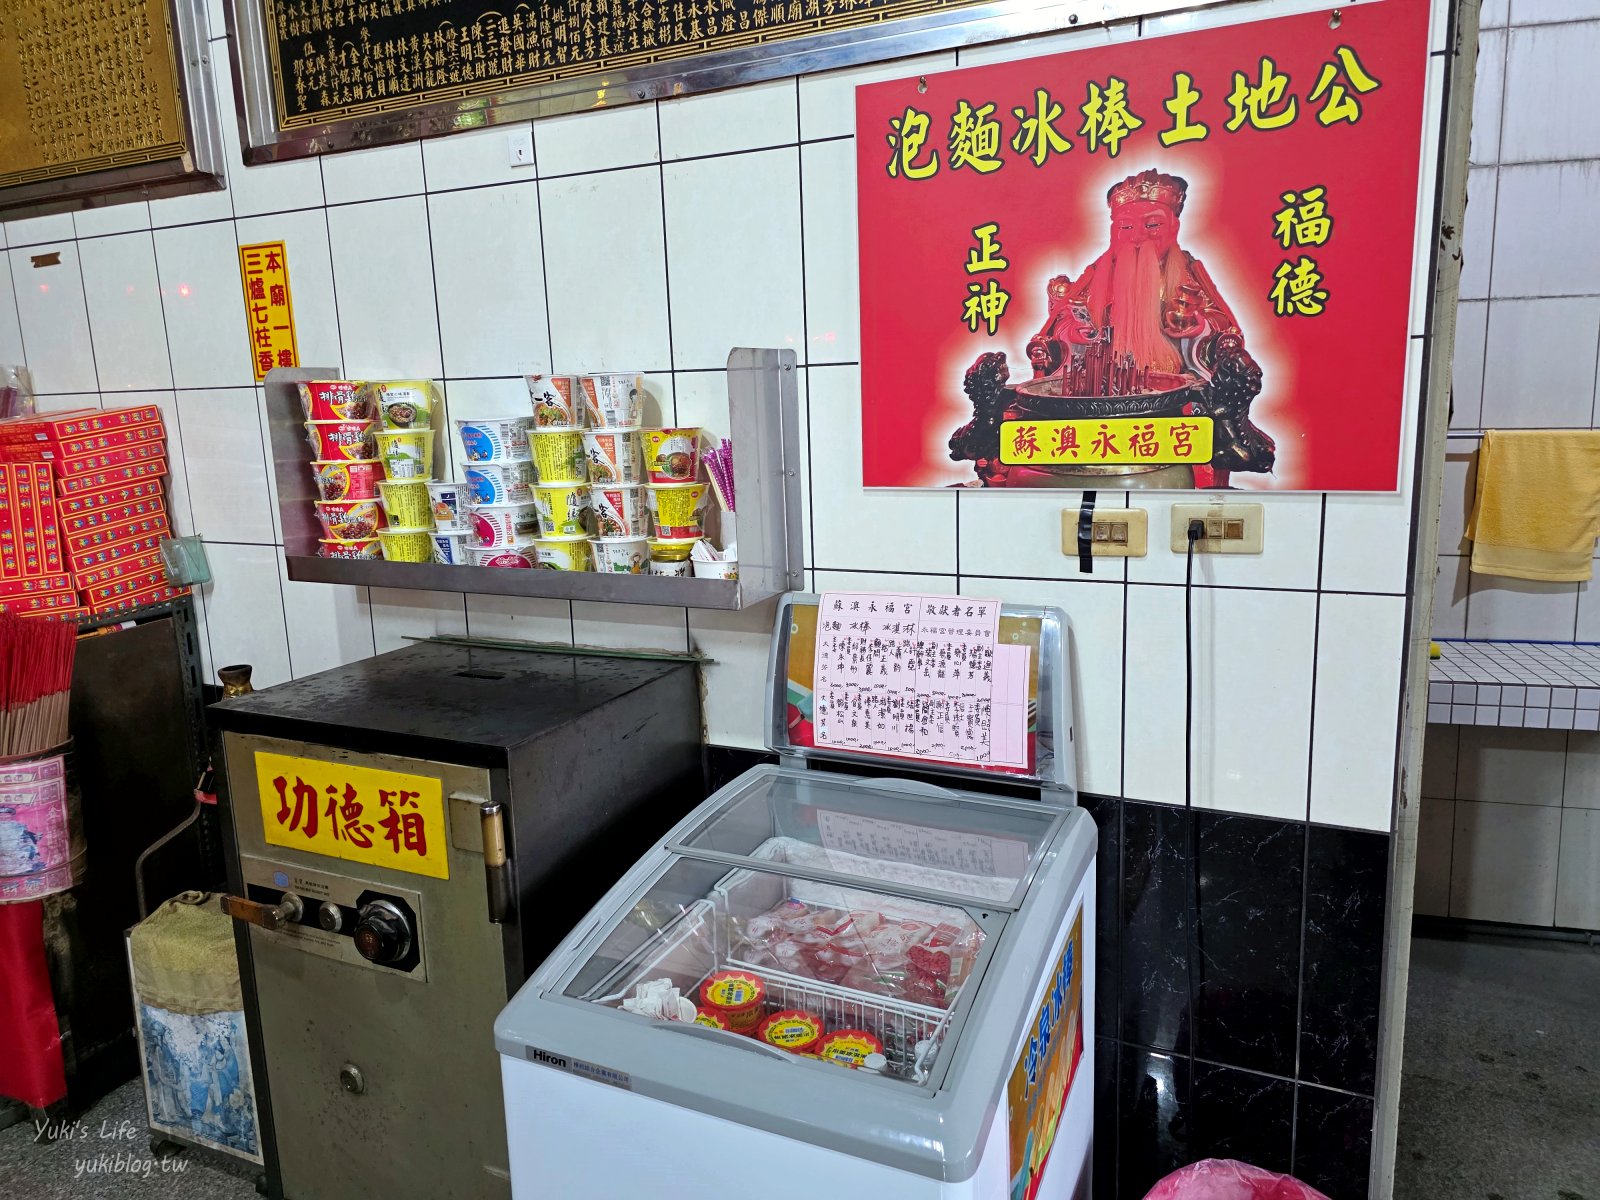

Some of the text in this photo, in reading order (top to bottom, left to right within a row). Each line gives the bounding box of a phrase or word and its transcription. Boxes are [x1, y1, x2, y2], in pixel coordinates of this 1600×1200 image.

[539, 0, 555, 66] 仟陸佰元
[962, 222, 1011, 335] 正神
[1270, 185, 1332, 317] 福德
[1011, 424, 1201, 459] 蘇澳永福宮
[273, 775, 427, 857] 功德箱
[533, 1049, 567, 1068] Hiron
